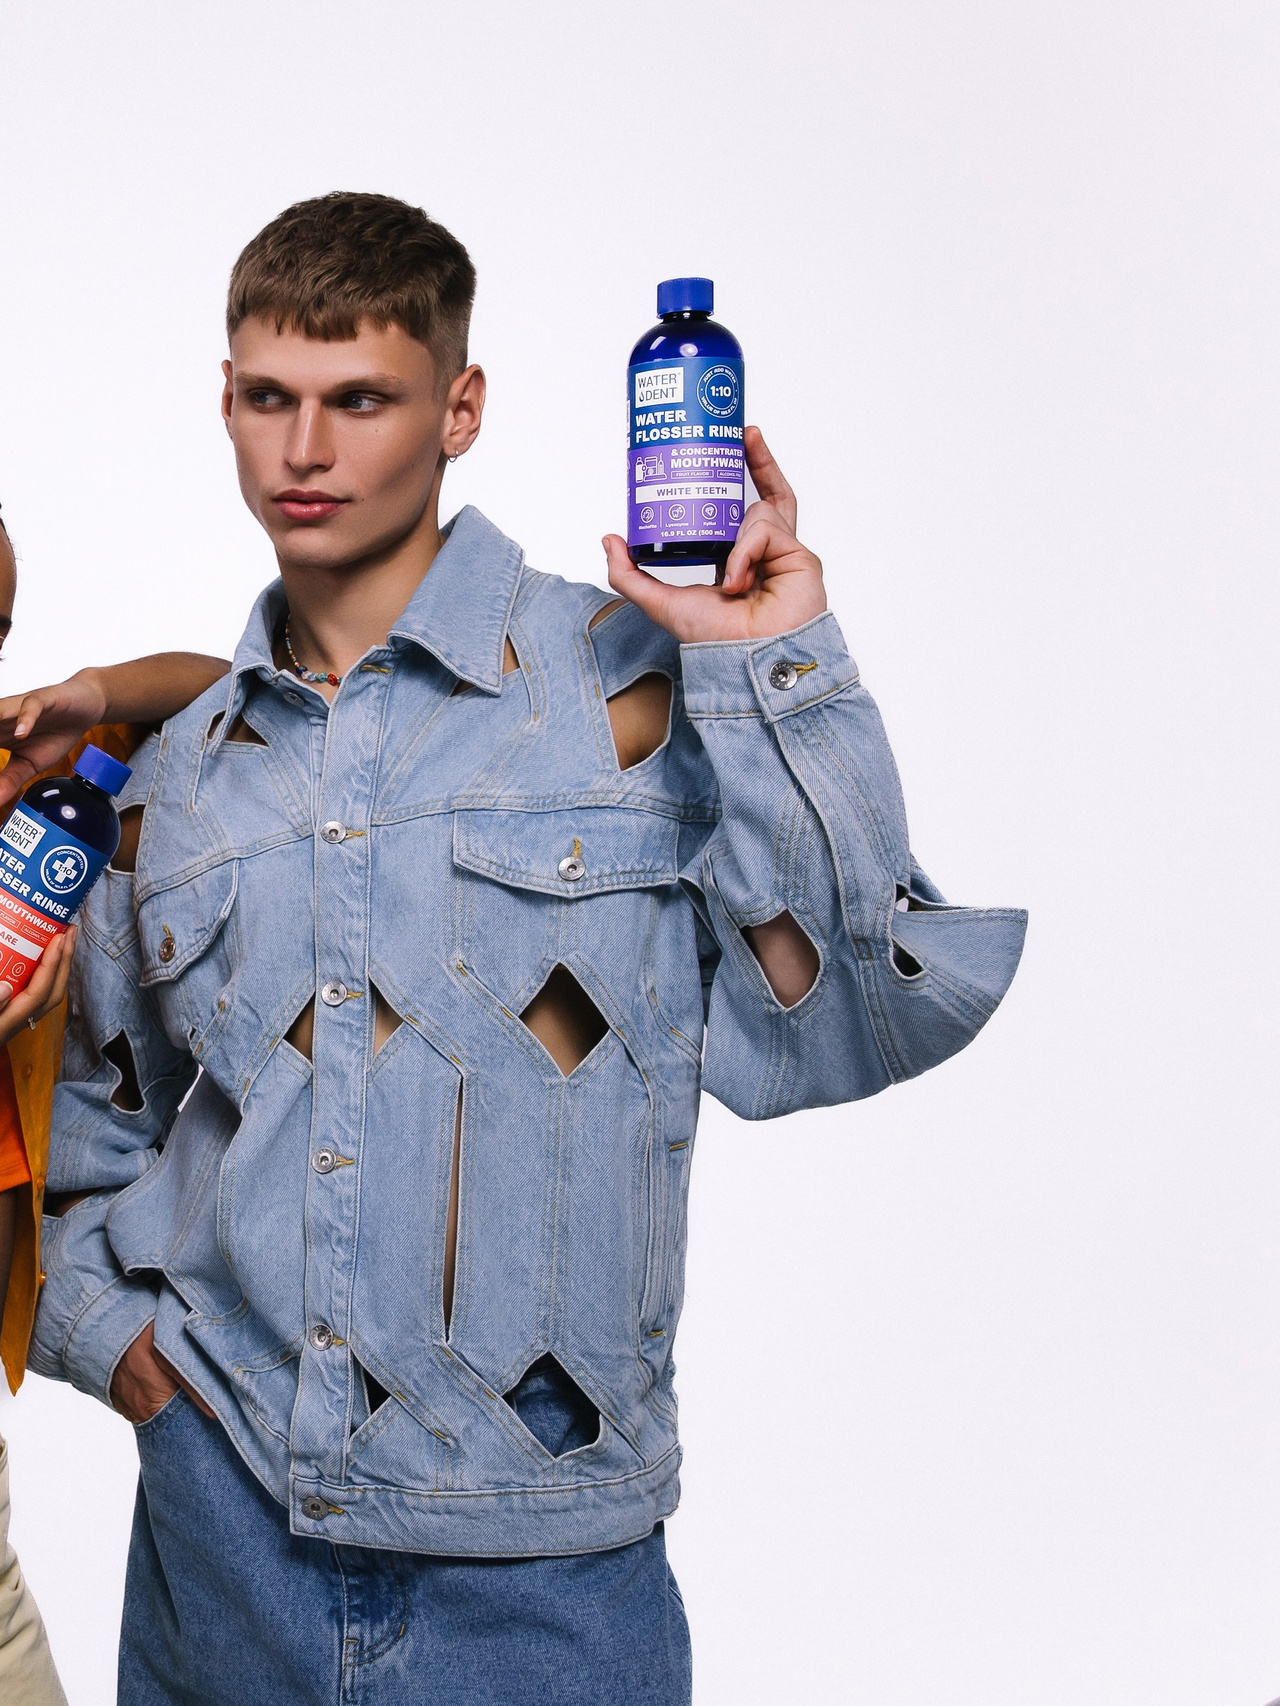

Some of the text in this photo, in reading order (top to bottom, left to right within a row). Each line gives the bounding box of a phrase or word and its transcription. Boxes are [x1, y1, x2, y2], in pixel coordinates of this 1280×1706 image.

[638, 373, 677, 388] WATER
[646, 387, 677, 401] DENT
[710, 385, 732, 397] 1:10
[636, 410, 687, 426] WATER
[636, 425, 743, 443] FLOSSER RINSE
[680, 447, 743, 457] CONCENTRATED
[671, 457, 743, 469] MOUTHWASH
[657, 487, 728, 497] WHITE TEETH
[10, 813, 38, 840] WATER
[7, 827, 32, 850] DENT
[56, 850, 84, 870] CONCENTRATED
[58, 864, 72, 876] 1:10
[31, 891, 70, 919] RINSE
